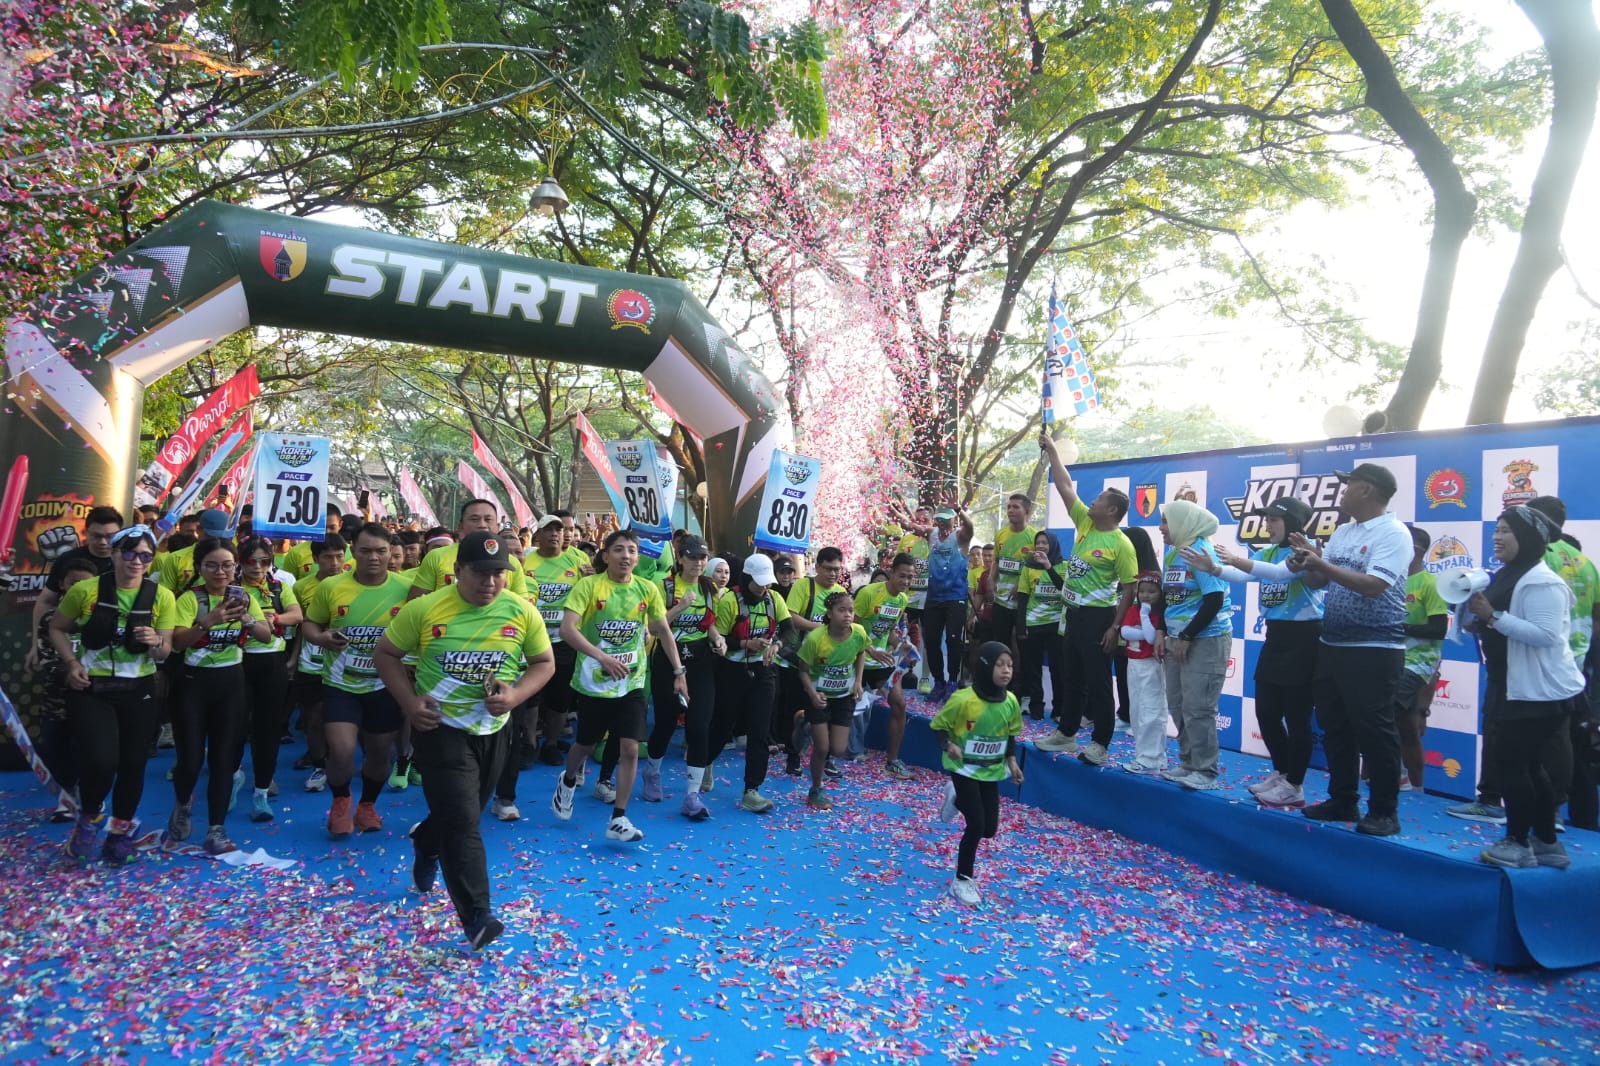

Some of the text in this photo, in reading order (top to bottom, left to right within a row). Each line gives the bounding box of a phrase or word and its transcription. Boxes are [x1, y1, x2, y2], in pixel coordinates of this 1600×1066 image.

[326, 245, 597, 327] START
[185, 387, 233, 442] Parrot
[266, 483, 320, 526] 7.30
[624, 486, 659, 526] 8.30
[767, 499, 808, 540] 8.30
[8, 575, 49, 592] SEM
[602, 620, 637, 630] KOREM
[352, 656, 376, 669] 1110
[444, 651, 505, 664] KOREM
[972, 741, 1002, 755] 10100
